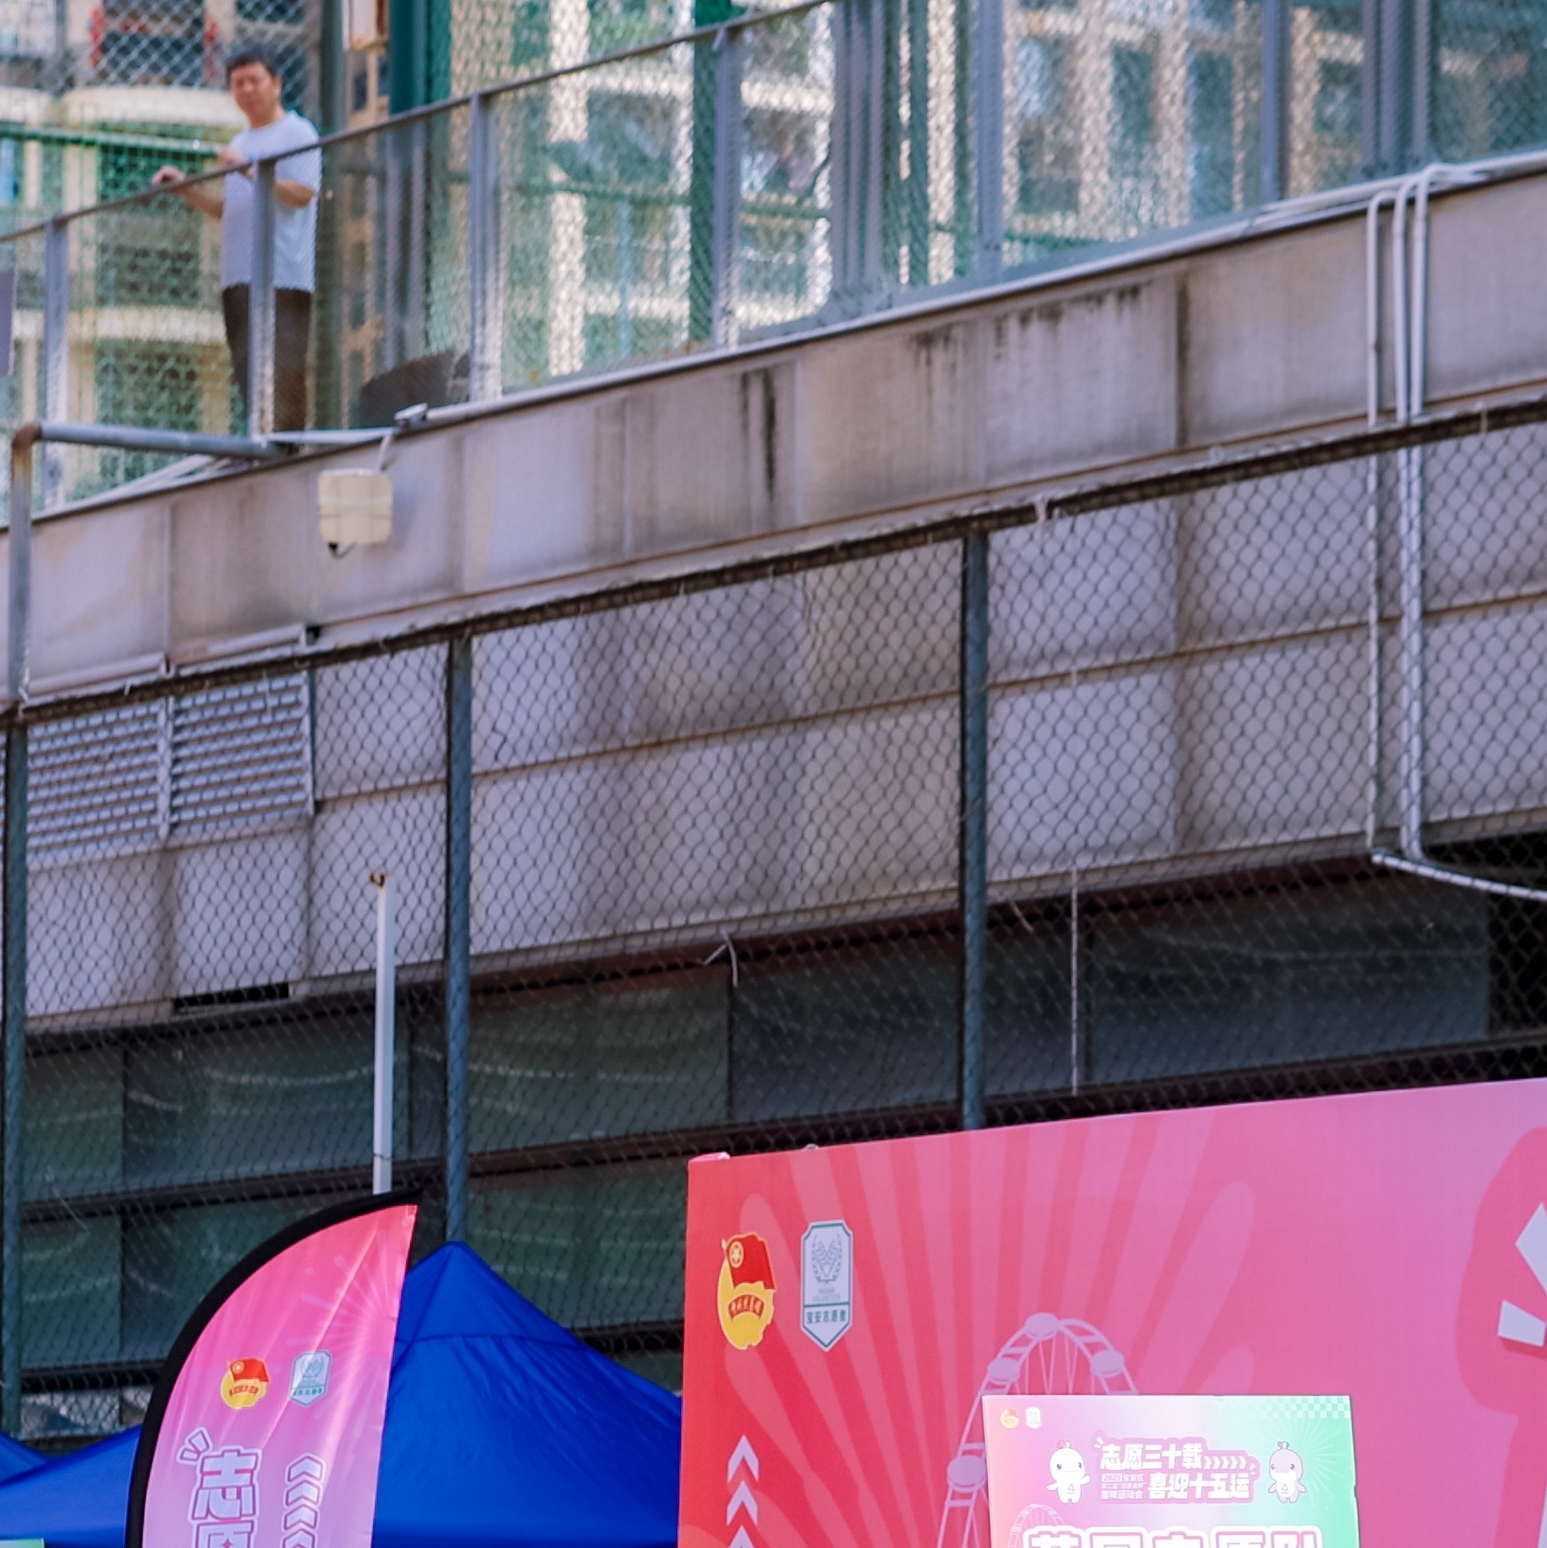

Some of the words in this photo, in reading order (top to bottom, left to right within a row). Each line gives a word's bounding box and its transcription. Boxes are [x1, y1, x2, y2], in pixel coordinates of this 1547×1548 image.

[1100, 1443, 1202, 1471] 志愿三十载
[1148, 1472, 1250, 1500] 喜迎十五运
